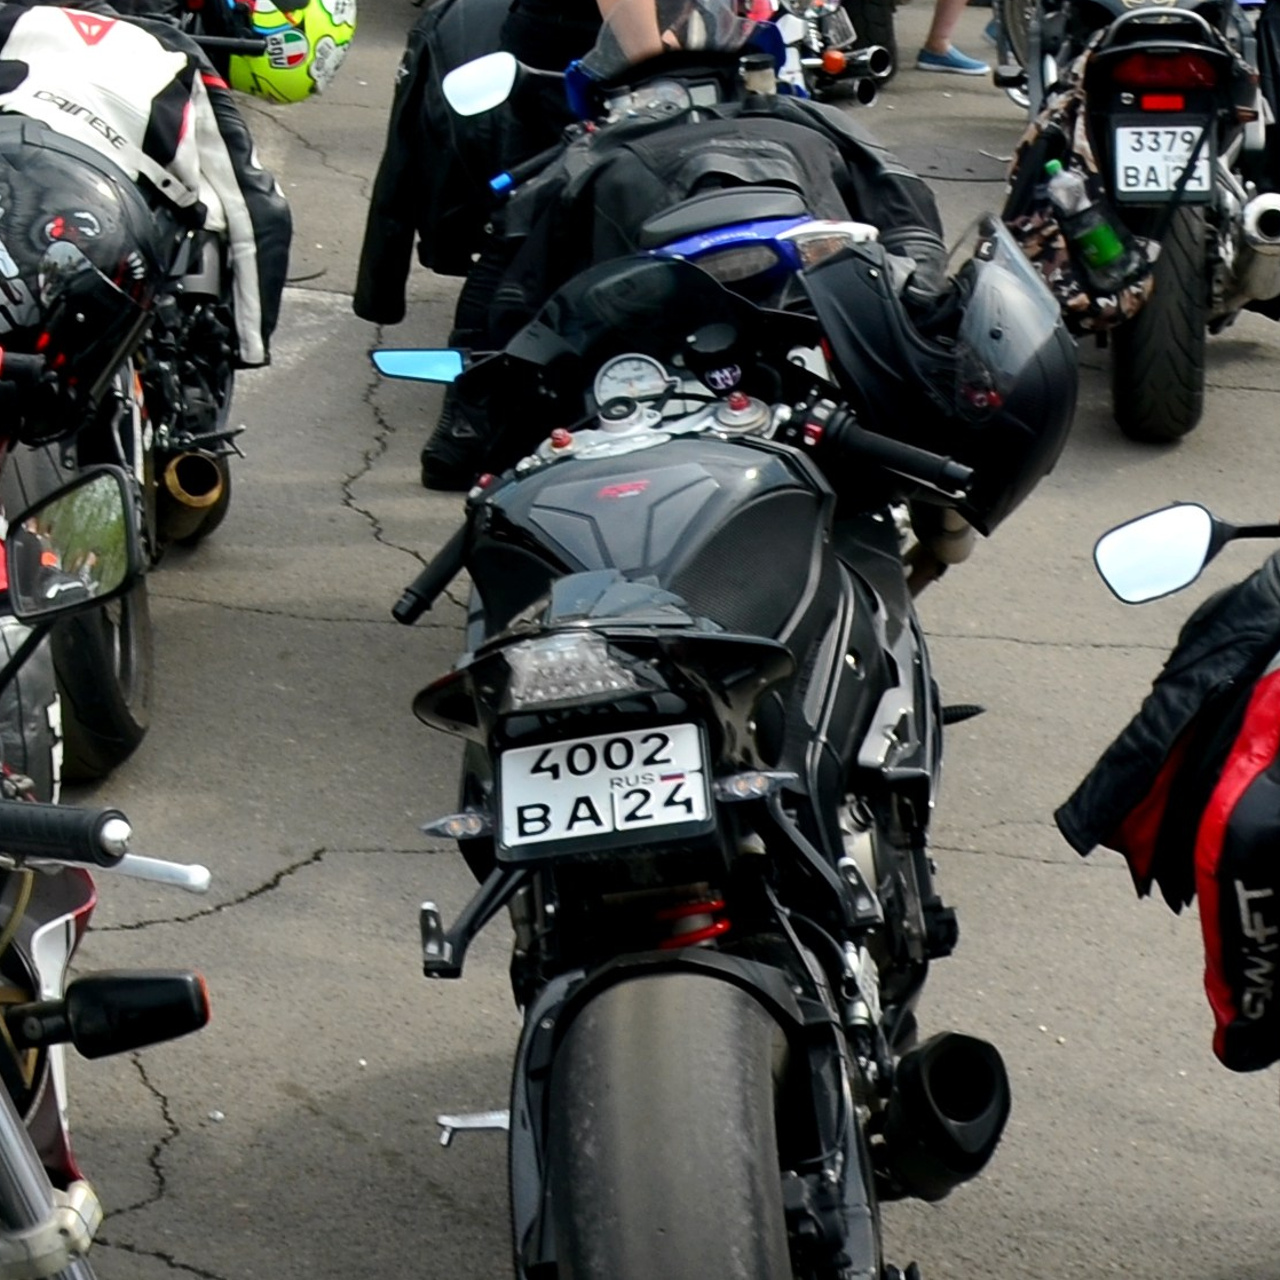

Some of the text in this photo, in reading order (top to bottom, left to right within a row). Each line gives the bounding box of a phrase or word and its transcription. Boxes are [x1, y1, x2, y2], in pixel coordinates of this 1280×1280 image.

[1130, 130, 1195, 153] 3379
[1124, 166, 1161, 188] BA
[530, 732, 673, 781] 4002
[609, 773, 656, 790] RUS
[516, 782, 694, 838] BA 24
